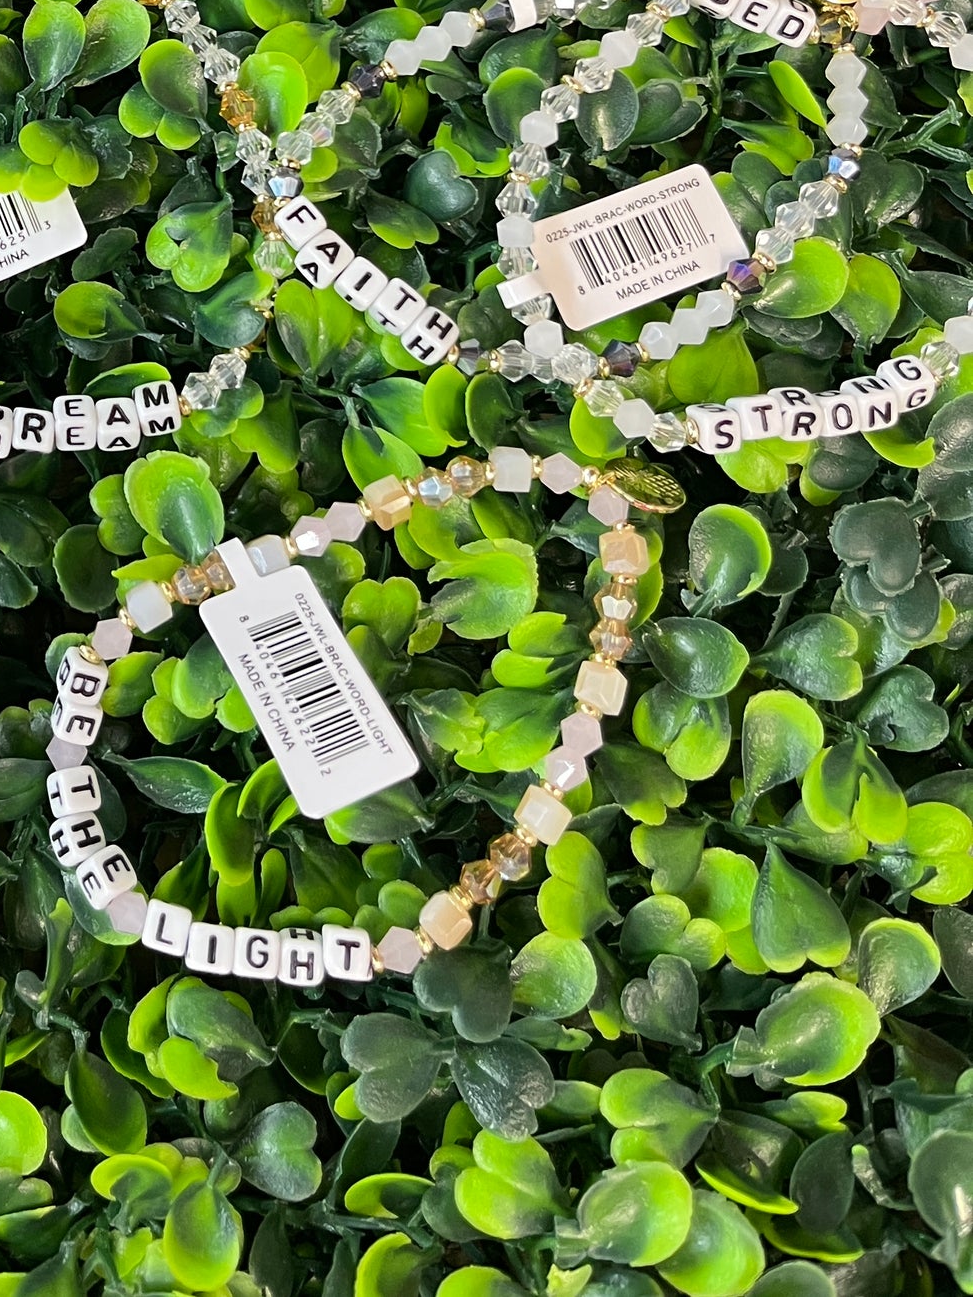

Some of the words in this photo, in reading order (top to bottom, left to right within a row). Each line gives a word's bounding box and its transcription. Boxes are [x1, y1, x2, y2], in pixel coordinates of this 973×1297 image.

[45, 221, 51, 229] 3
[546, 178, 700, 243] 0225-JWL-BRAC-WORD-STRONG
[287, 205, 452, 360] FAITH
[579, 286, 585, 295] 8
[605, 262, 646, 283] 40461
[654, 243, 692, 264] 49627
[709, 234, 715, 242] 7
[616, 280, 651, 299] MADE
[653, 274, 664, 285] IN
[666, 260, 700, 280] CHINA
[699, 360, 927, 448] STRONG
[52, 656, 100, 736] BE
[238, 654, 266, 690] MADE
[255, 644, 284, 687] 40461
[284, 698, 315, 745] 49622
[261, 692, 274, 707] IN
[295, 593, 393, 754] 0225-JWL-BRAC-WORD-LIGHT
[267, 708, 295, 752] CHINA
[49, 774, 130, 898] THE
[156, 913, 360, 980] LIGHT
